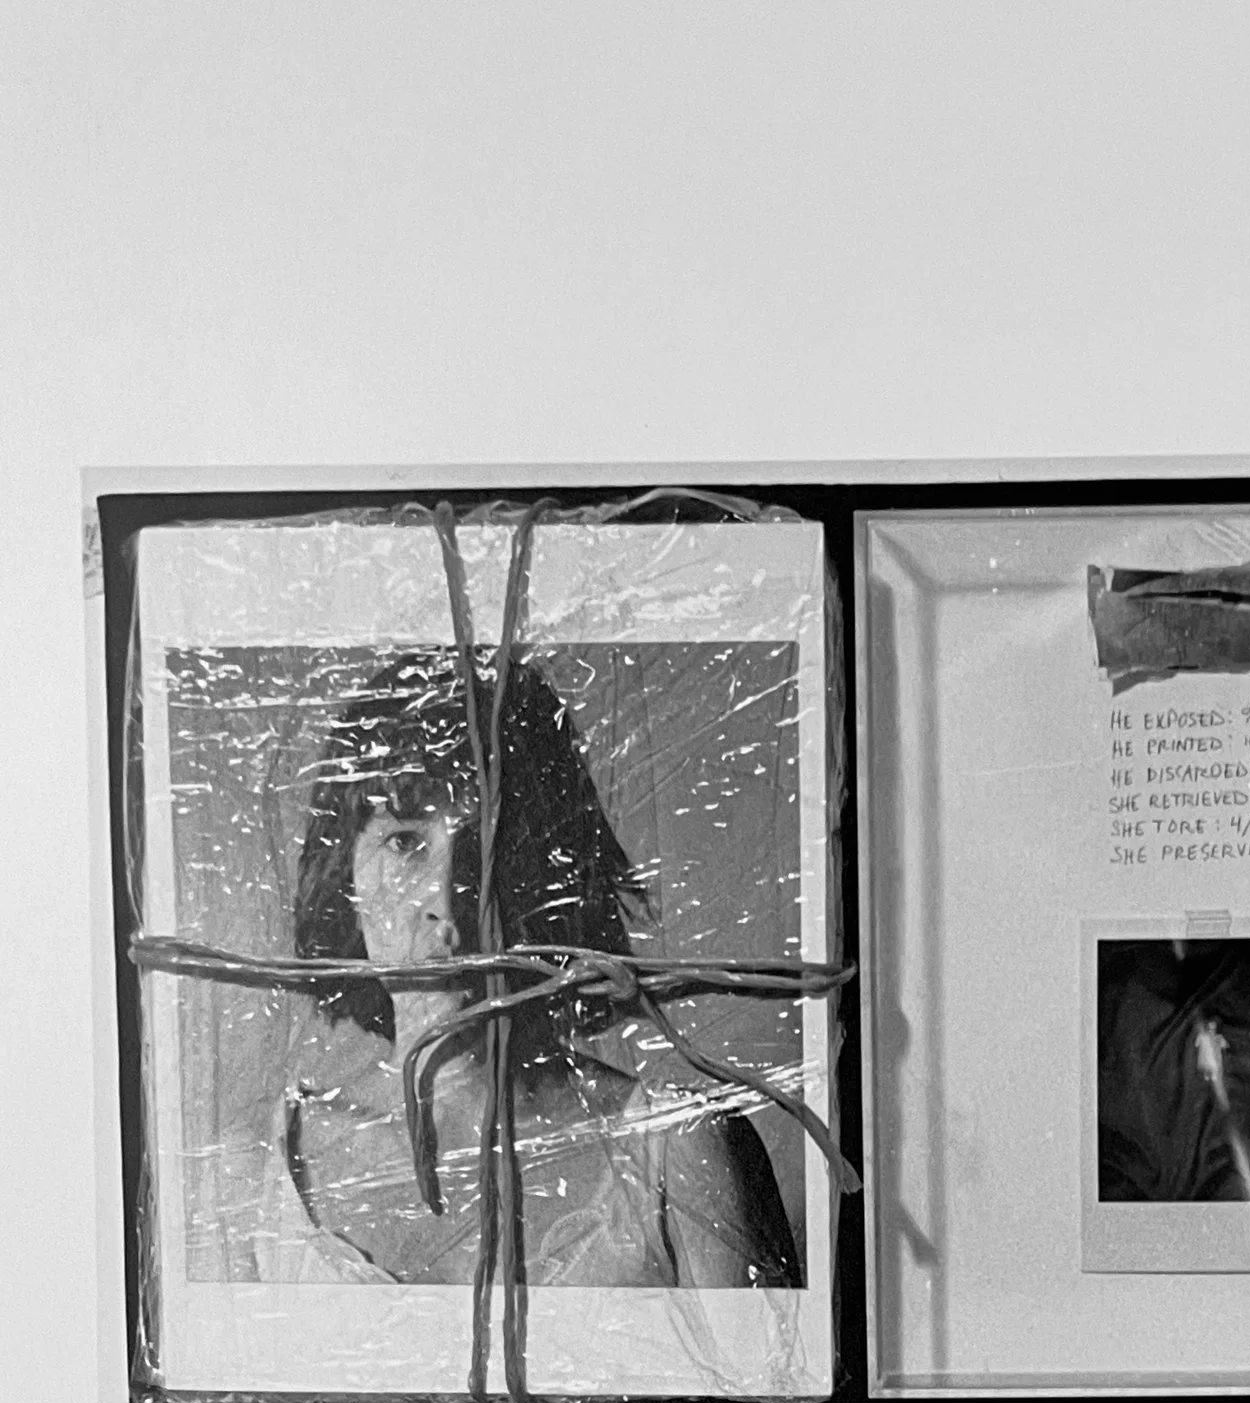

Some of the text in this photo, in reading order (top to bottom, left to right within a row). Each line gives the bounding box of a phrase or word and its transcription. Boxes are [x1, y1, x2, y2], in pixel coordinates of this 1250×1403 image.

[1110, 710, 1132, 730] HE
[1144, 708, 1232, 730] EXPOSED:
[1112, 739, 1133, 759] HE
[1147, 734, 1232, 755] PRINTED:
[1110, 769, 1133, 788] HE
[1109, 793, 1140, 814] SHE
[1110, 821, 1145, 838] SHE
[1110, 846, 1147, 865] SHE
